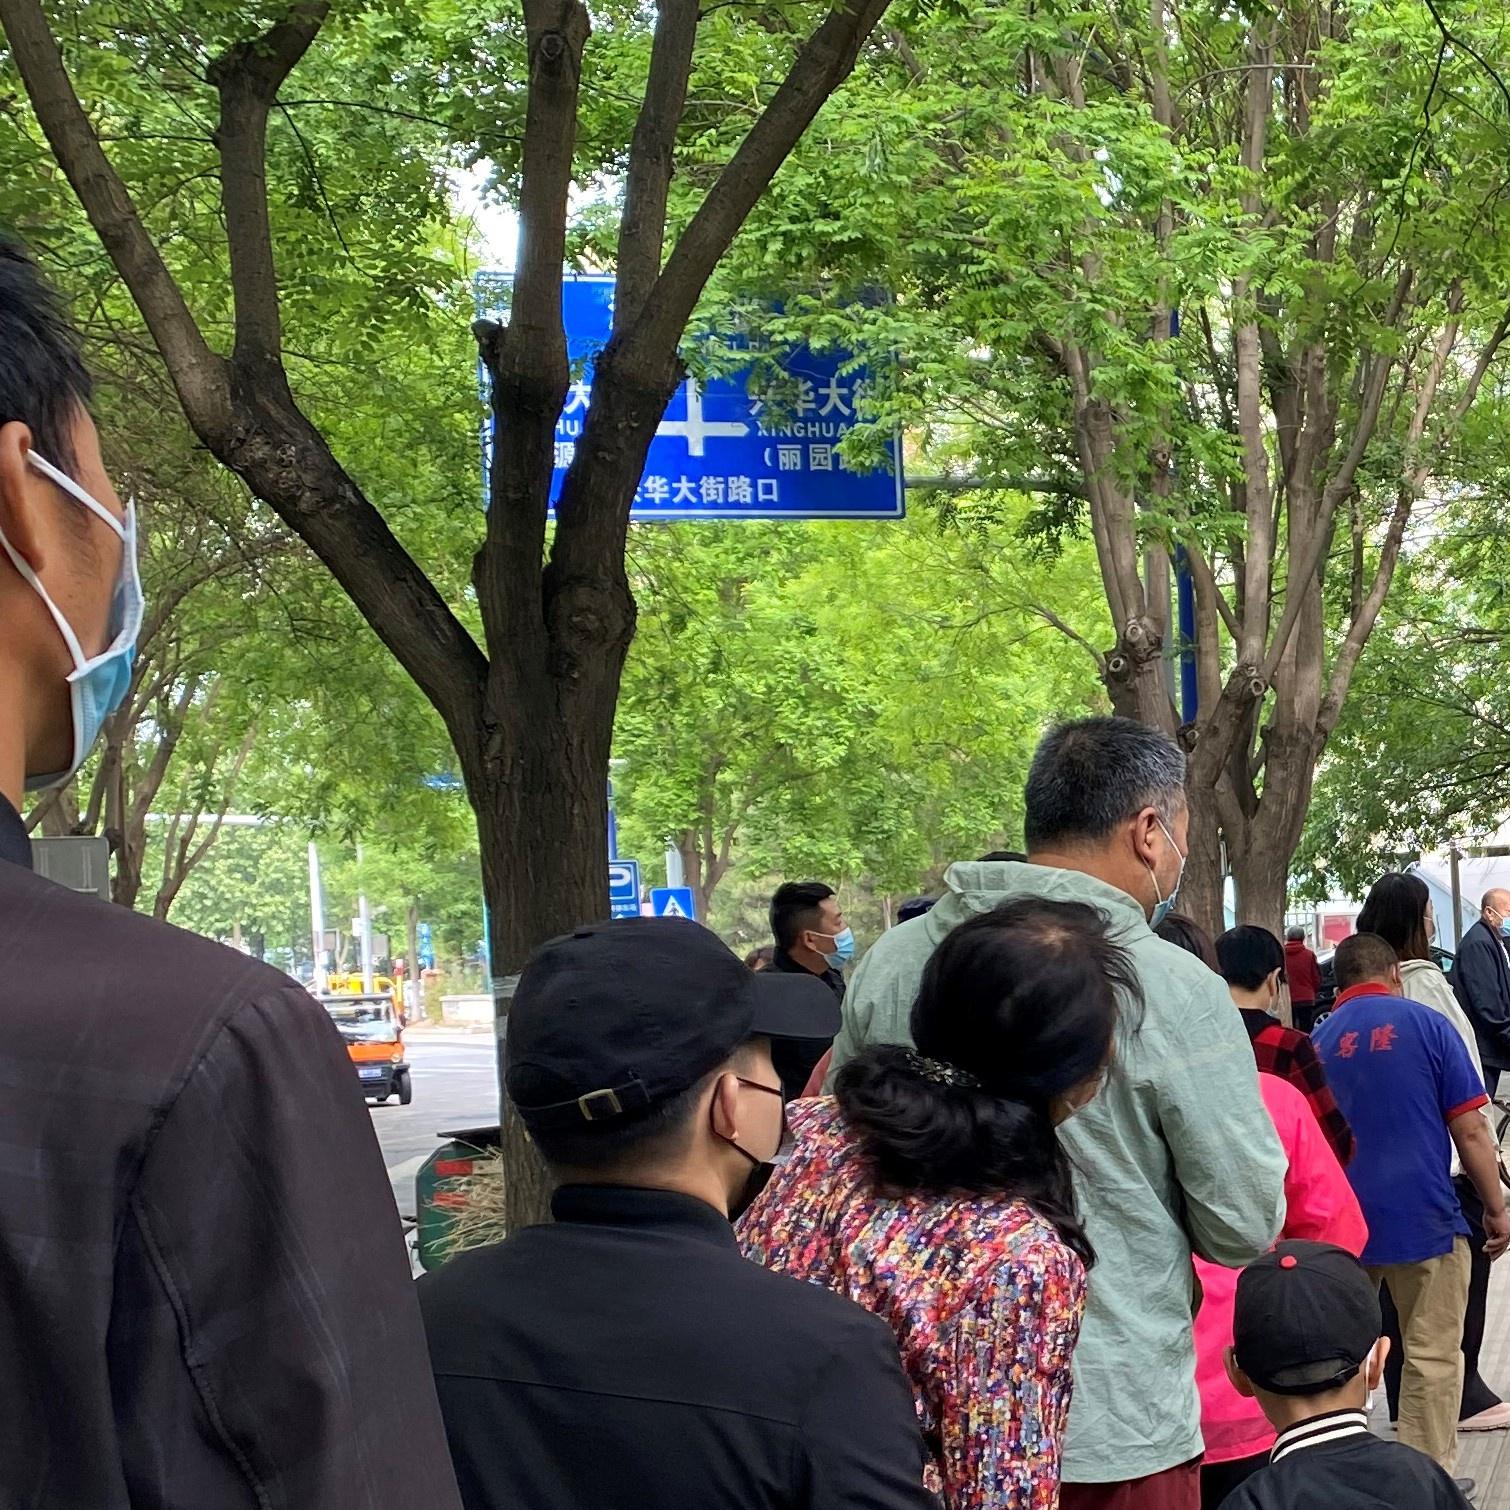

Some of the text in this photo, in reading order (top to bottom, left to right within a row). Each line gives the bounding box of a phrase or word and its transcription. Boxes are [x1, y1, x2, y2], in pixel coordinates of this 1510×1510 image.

[749, 376, 875, 420] 华大
[631, 475, 778, 504] 华大街路口
